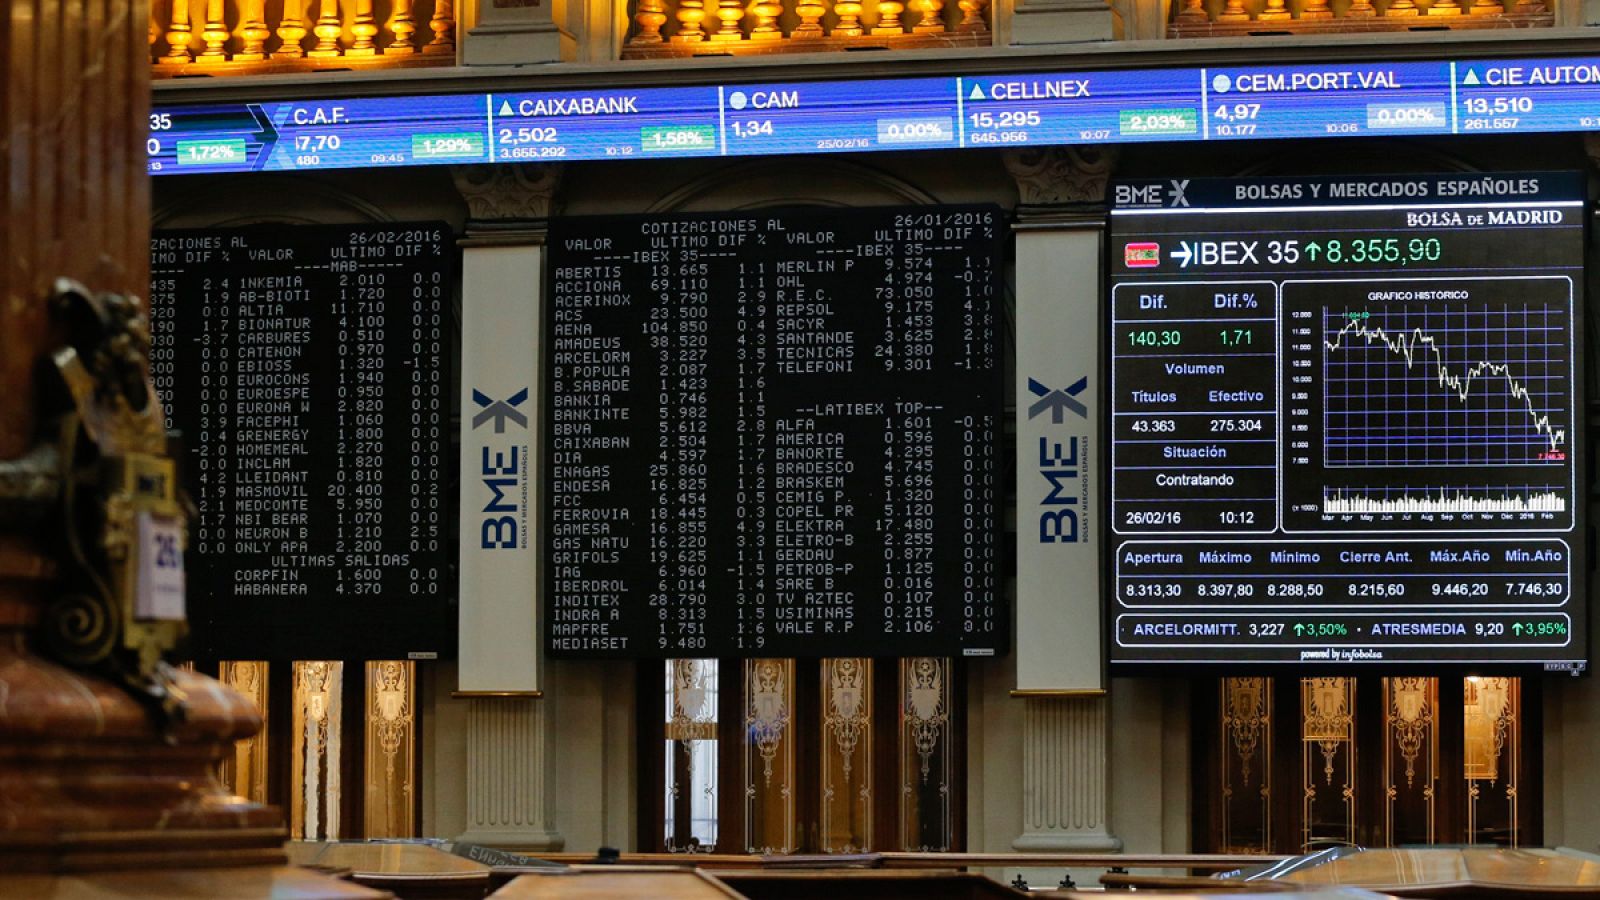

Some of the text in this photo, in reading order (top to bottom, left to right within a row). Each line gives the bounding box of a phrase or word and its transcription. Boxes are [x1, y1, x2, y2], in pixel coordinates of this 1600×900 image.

[1235, 71, 1400, 92] CEM.PORT.VAL
[1486, 67, 1528, 86] CIE
[990, 80, 1090, 99] CELLNEX
[519, 96, 639, 117] CAIXABANK
[752, 91, 798, 109] CAM
[1464, 97, 1533, 115] 13,510
[294, 107, 349, 125] C.A.F.
[970, 111, 1185, 131] 15,295 2,03%
[1214, 103, 1435, 125] 4,97 0,00%
[731, 120, 942, 139] 1,34 0,00%
[1215, 123, 1358, 136] 10.177 10:06
[1464, 118, 1520, 130] 261.557
[499, 127, 557, 145] 2,502
[971, 130, 1110, 144] 645.956 10:07
[422, 137, 472, 154] 1,29%
[816, 138, 869, 149] 25/02/16
[188, 144, 234, 161] 1,72%
[500, 146, 633, 158] 3.655.292 10:12
[1115, 184, 1163, 204] BME
[1234, 177, 1539, 200] BOLSAS Y MERCADOS ESPAÑOLES
[641, 213, 993, 234] COTIZACIONES AL 26/01/2016
[1407, 212, 1464, 227] BOLSA
[1488, 210, 1563, 225] MADRID
[350, 231, 441, 244] 26/02/2016
[565, 234, 765, 250] VALOR ULTIMO DIF %
[787, 227, 992, 243] VALOR ULTIMO DIF %
[331, 246, 385, 258] ULTIMO
[396, 245, 421, 256] DIF
[433, 244, 440, 255] %
[1193, 238, 1441, 266] IBEX 35 8.355,90
[556, 263, 763, 279] ABERTIS 13.665 1.1
[556, 277, 764, 292] ACCIONA 69.110 1.1
[556, 291, 765, 307] ACERINOX 9.790 2.9
[1139, 293, 1258, 309] Dif. Dif.%
[777, 301, 932, 316] REPSOL 9.175
[239, 314, 440, 330] BIONATUR 4.100 0.0
[239, 332, 310, 344] CARBURES
[555, 337, 620, 349] AMADEUS
[777, 332, 853, 344] SANTANDE
[1128, 329, 1253, 348] 140,30 1,71
[555, 352, 630, 364] ARCELORM
[778, 361, 852, 372] TELEFONI
[1164, 363, 1225, 375] Volumen
[555, 395, 610, 407] BANKIA
[1208, 390, 1264, 402] Efectivo
[555, 408, 629, 420] BANKINTE
[1131, 419, 1262, 433] 43.363 275.304
[237, 429, 308, 441] GRENERGY
[237, 444, 308, 455] HOMEMEAL
[555, 437, 629, 449] CAIXABAN
[776, 448, 843, 459] BANORTE
[1163, 445, 1227, 458] Situación
[554, 466, 609, 478] ENAGAS
[776, 461, 853, 473] BRADESCO
[1155, 473, 1234, 486] Contratando
[236, 485, 307, 496] MASMOVIL
[1039, 436, 1078, 543] BME
[481, 445, 518, 549] BME
[1126, 511, 1255, 525] 26/02/16 10:12
[272, 554, 409, 567] ULTIMAS SALIDAS
[1124, 549, 1562, 567] Apertura Máximo Mínimo Cierre Ant. Máx.Año Mín.Año
[235, 584, 307, 595] HABANERA
[555, 580, 628, 592] IBERDROL
[1126, 583, 1562, 598] 8.313,30 8.397,80 8.288,50 8.215,60 9.446,20 7.746,30
[776, 607, 853, 619] USIMINAS
[553, 624, 608, 635] MAPFRE
[1133, 622, 1567, 638] ARCELORMITT. 3,227 3,50% ATRESMEDIA 9,20 3,95%
[553, 637, 764, 649] MEDIASET 9.480 1.9
[1300, 647, 1383, 662] powered by infobolsa
